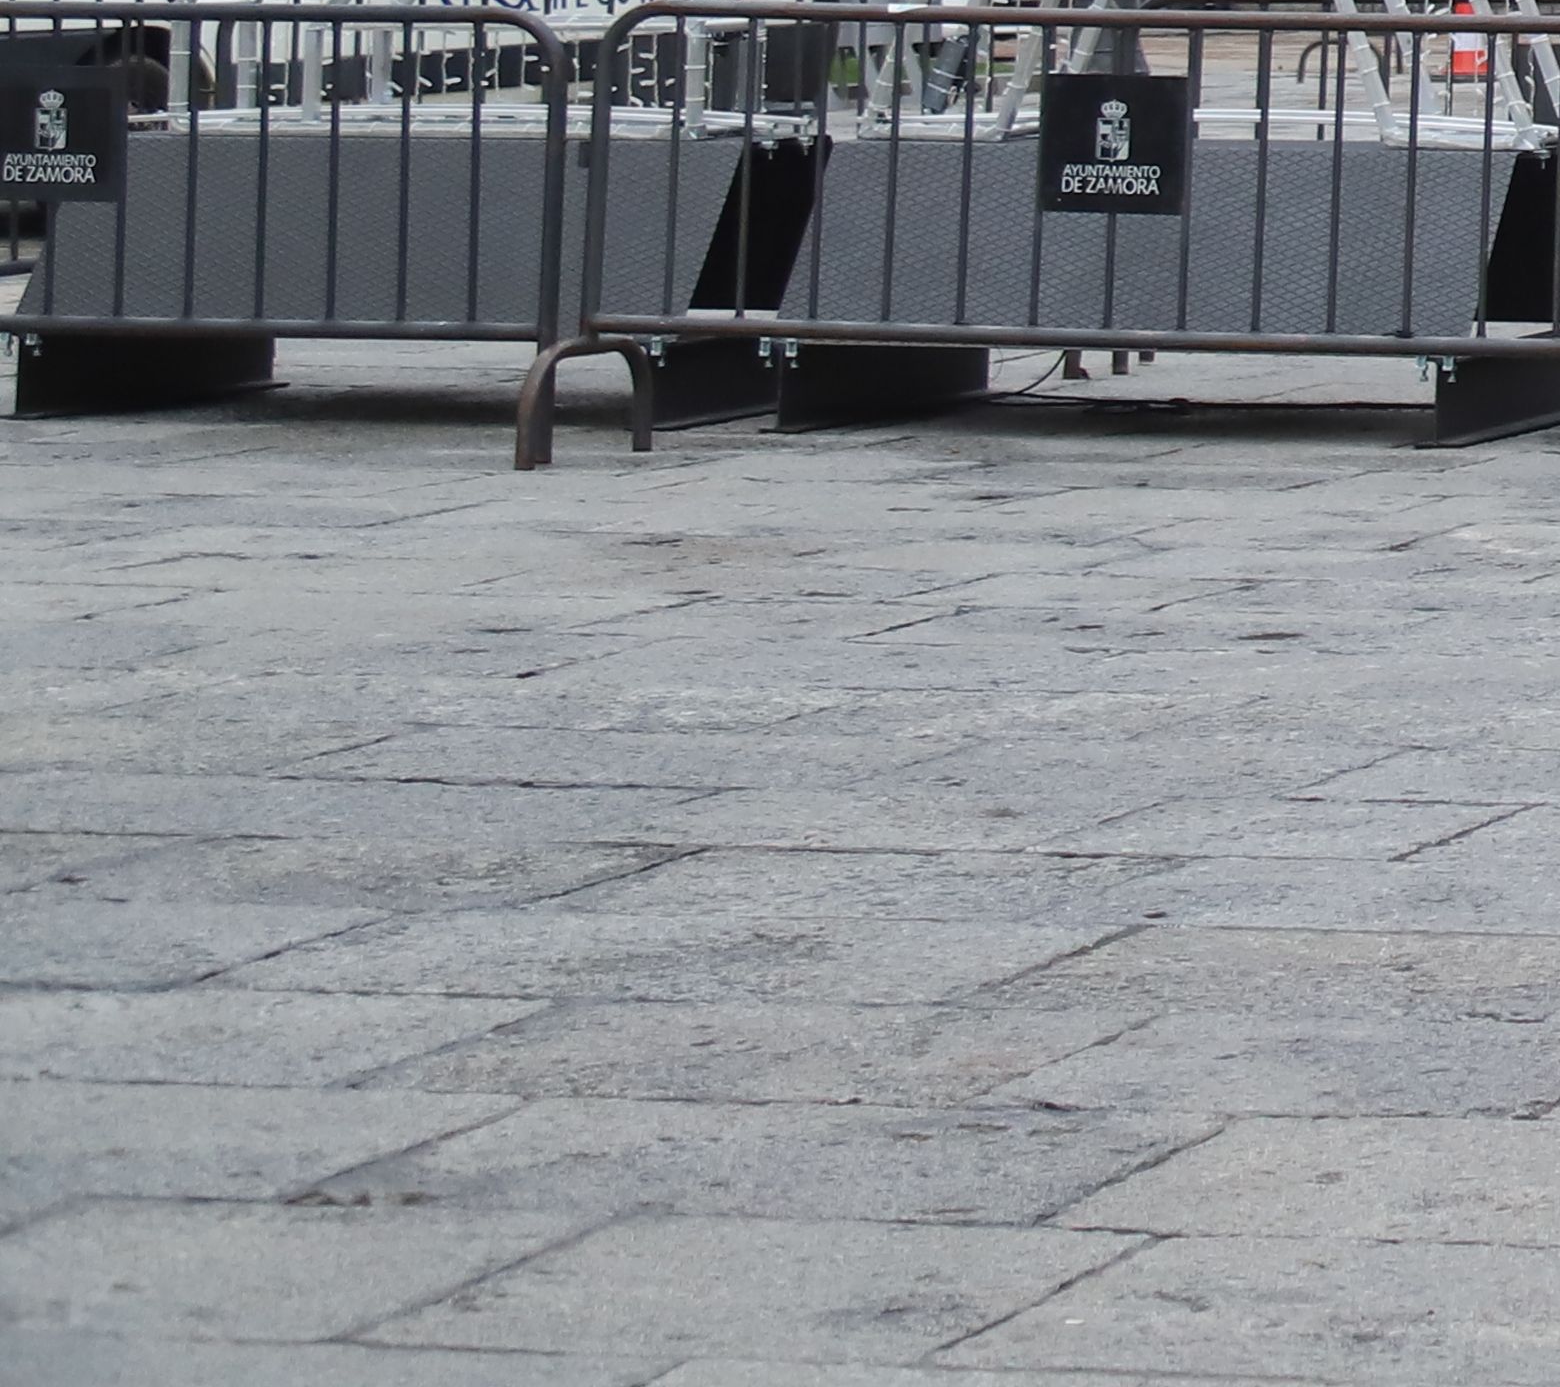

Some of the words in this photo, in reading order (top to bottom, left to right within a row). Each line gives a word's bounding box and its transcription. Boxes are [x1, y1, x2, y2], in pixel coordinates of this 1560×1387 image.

[3, 153, 97, 167] AYUNTAMIENTO
[3, 165, 23, 182] DE
[26, 166, 96, 183] ZAMORA
[1062, 164, 1160, 179] AYUNTAMIENTO
[1061, 177, 1083, 193] DE
[1085, 177, 1159, 195] ZAMORA
